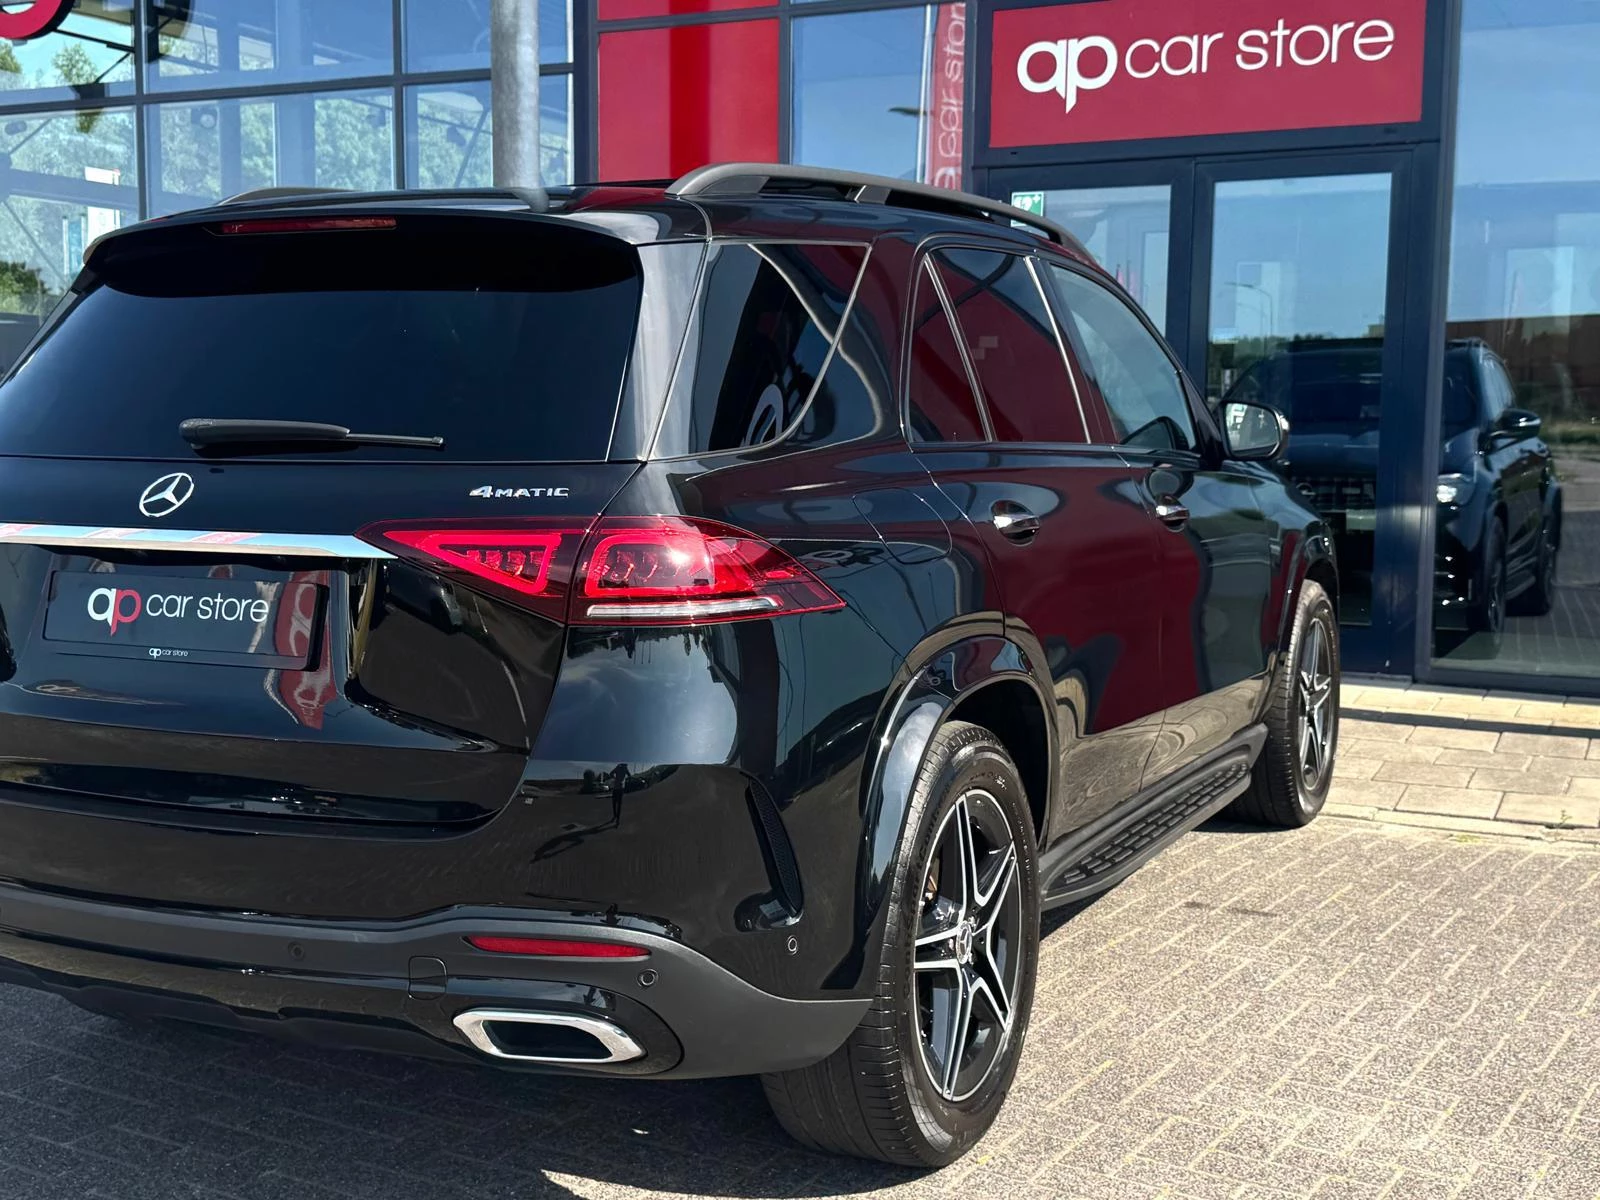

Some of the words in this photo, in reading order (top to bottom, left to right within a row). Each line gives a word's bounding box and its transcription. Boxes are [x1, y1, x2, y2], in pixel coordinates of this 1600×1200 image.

[1017, 36, 1118, 114] ap
[1125, 32, 1224, 79] car
[1235, 18, 1395, 71] store
[469, 485, 570, 498] 4MATIC
[87, 587, 142, 637] ap
[146, 593, 193, 618] car
[197, 592, 270, 623] store
